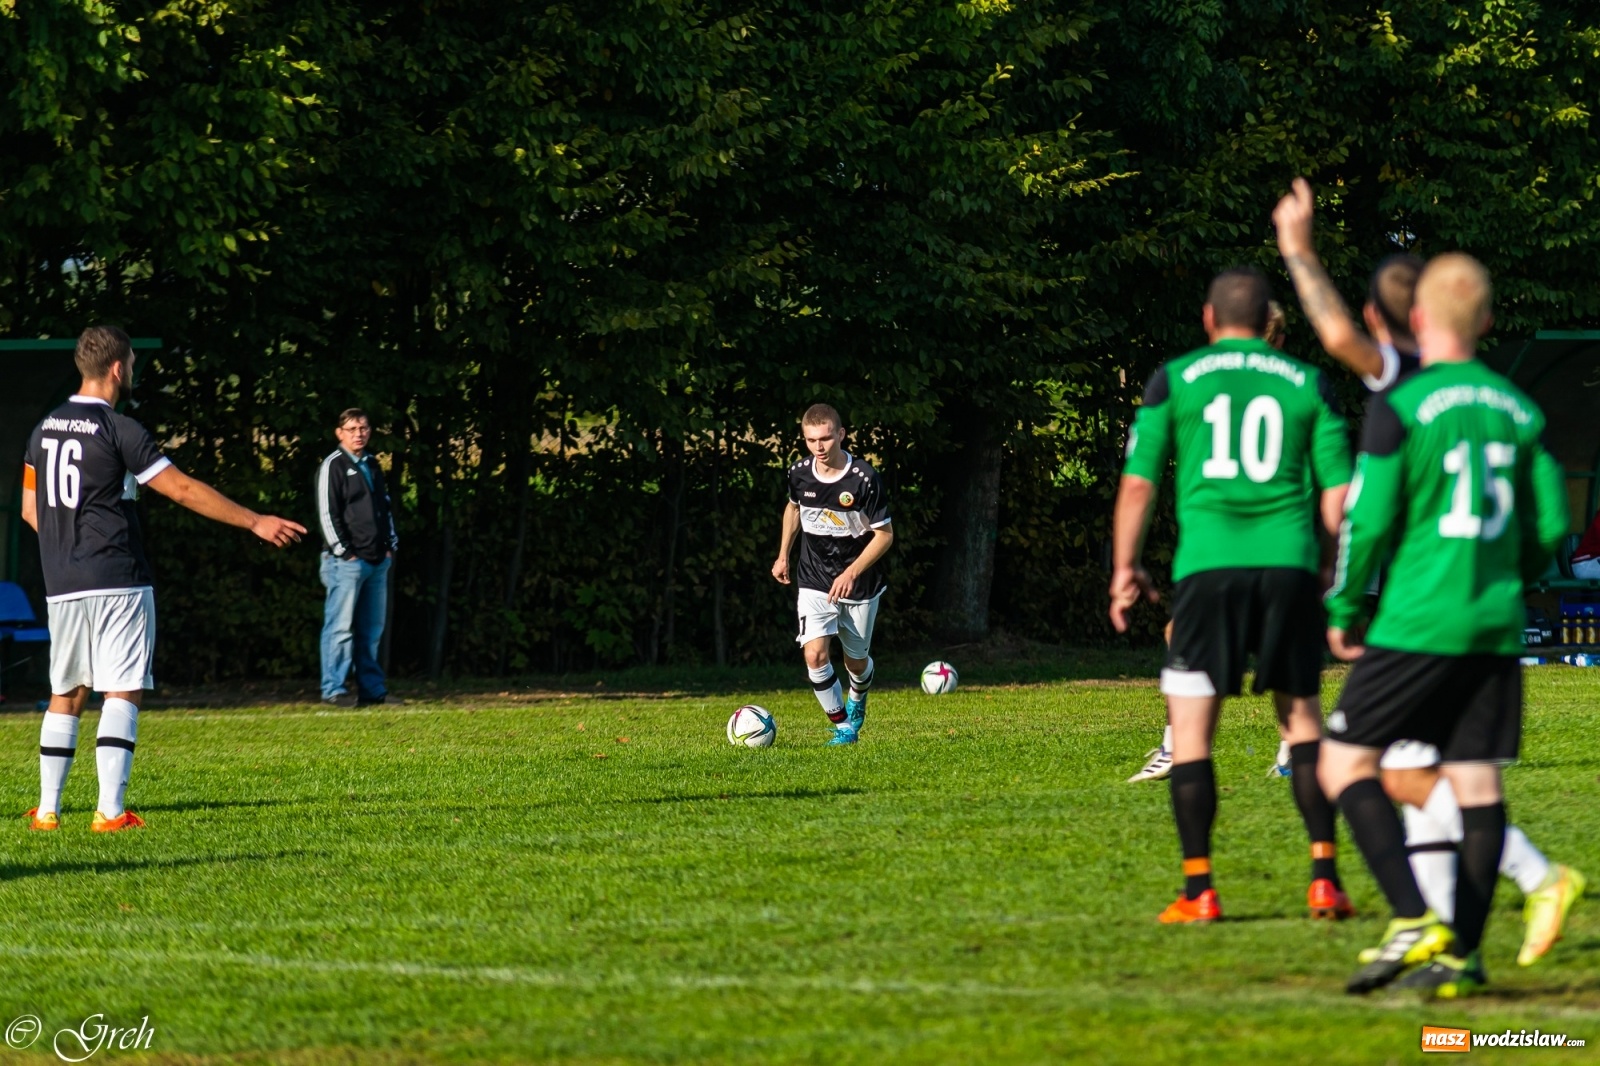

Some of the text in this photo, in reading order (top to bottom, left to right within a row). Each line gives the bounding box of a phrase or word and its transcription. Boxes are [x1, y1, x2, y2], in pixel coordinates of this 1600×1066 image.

[40, 437, 82, 509] 16
[1202, 393, 1284, 483] 10
[1438, 440, 1516, 542] 15
